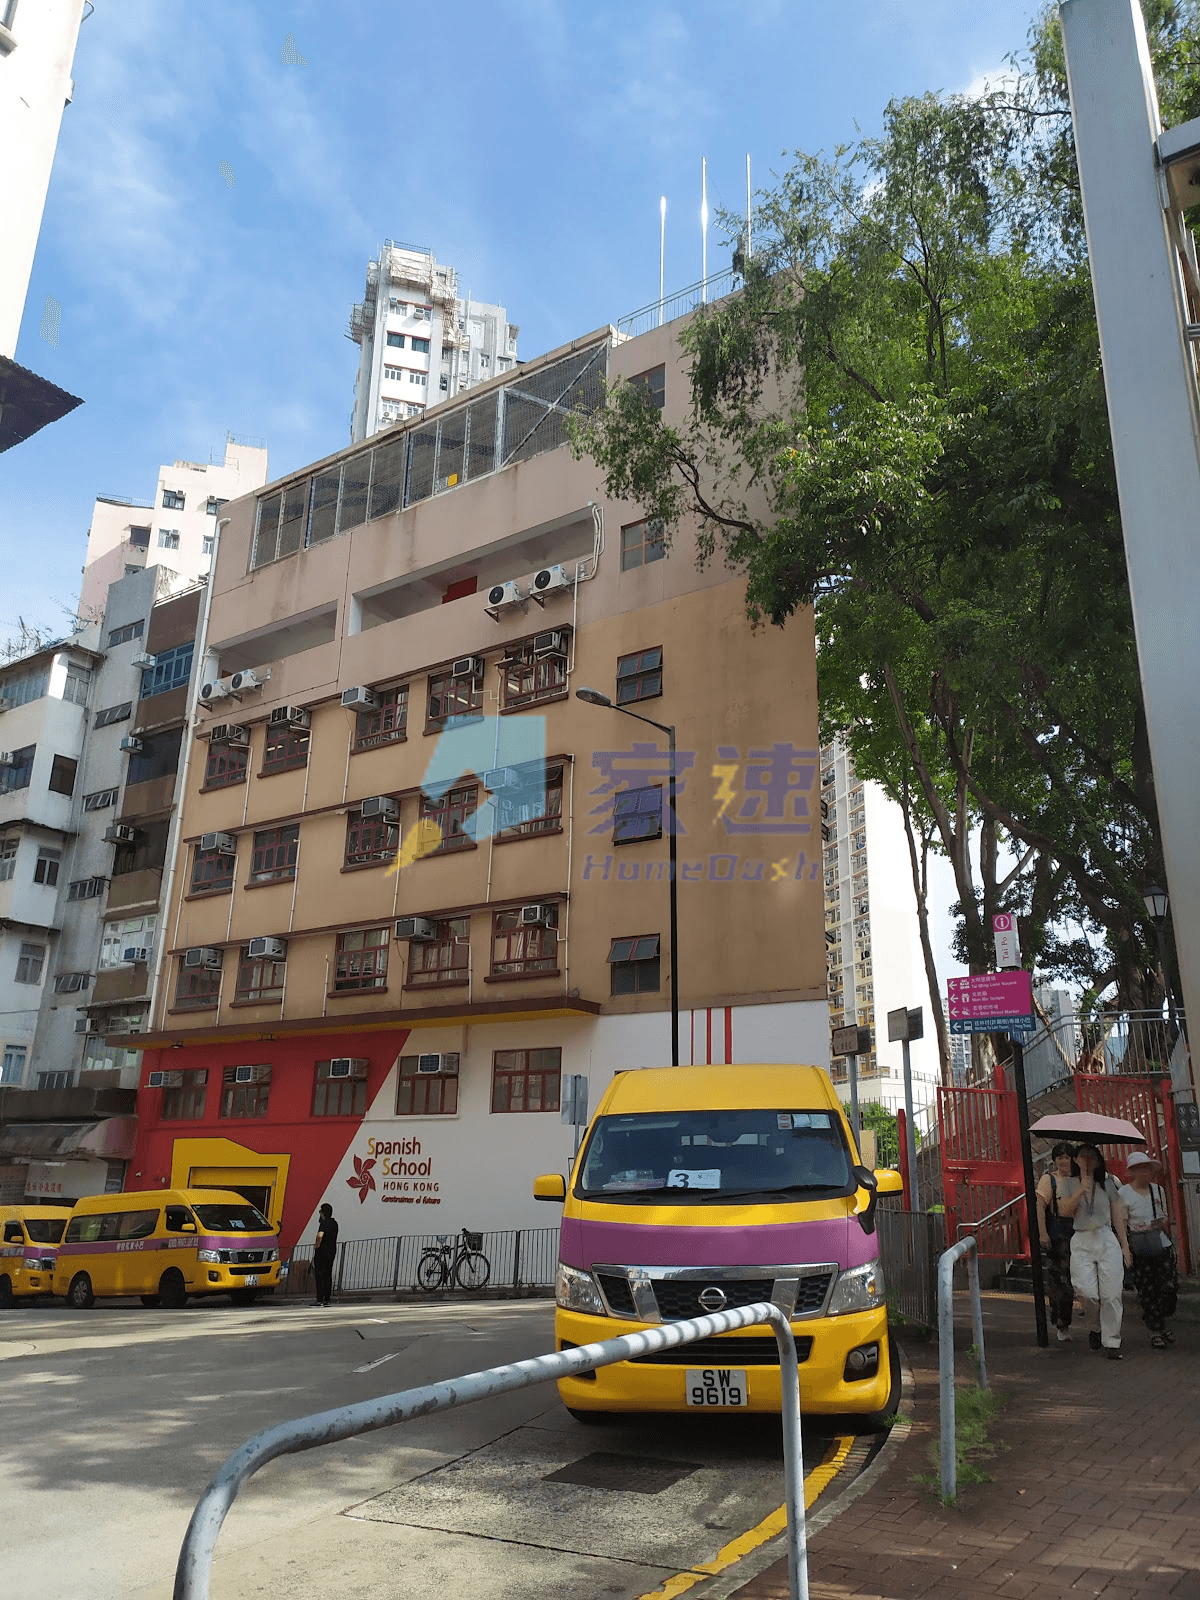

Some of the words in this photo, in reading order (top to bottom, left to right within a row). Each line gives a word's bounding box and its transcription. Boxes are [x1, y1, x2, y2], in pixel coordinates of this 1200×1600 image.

[1001, 936, 1008, 946] Po
[1002, 948, 1010, 961] Tai
[367, 1136, 421, 1159] Spanish
[382, 1157, 432, 1176] School
[383, 1181, 409, 1191] HONG
[413, 1182, 440, 1192] KONG
[702, 1369, 731, 1387] SW
[692, 1387, 742, 1406] 9619
